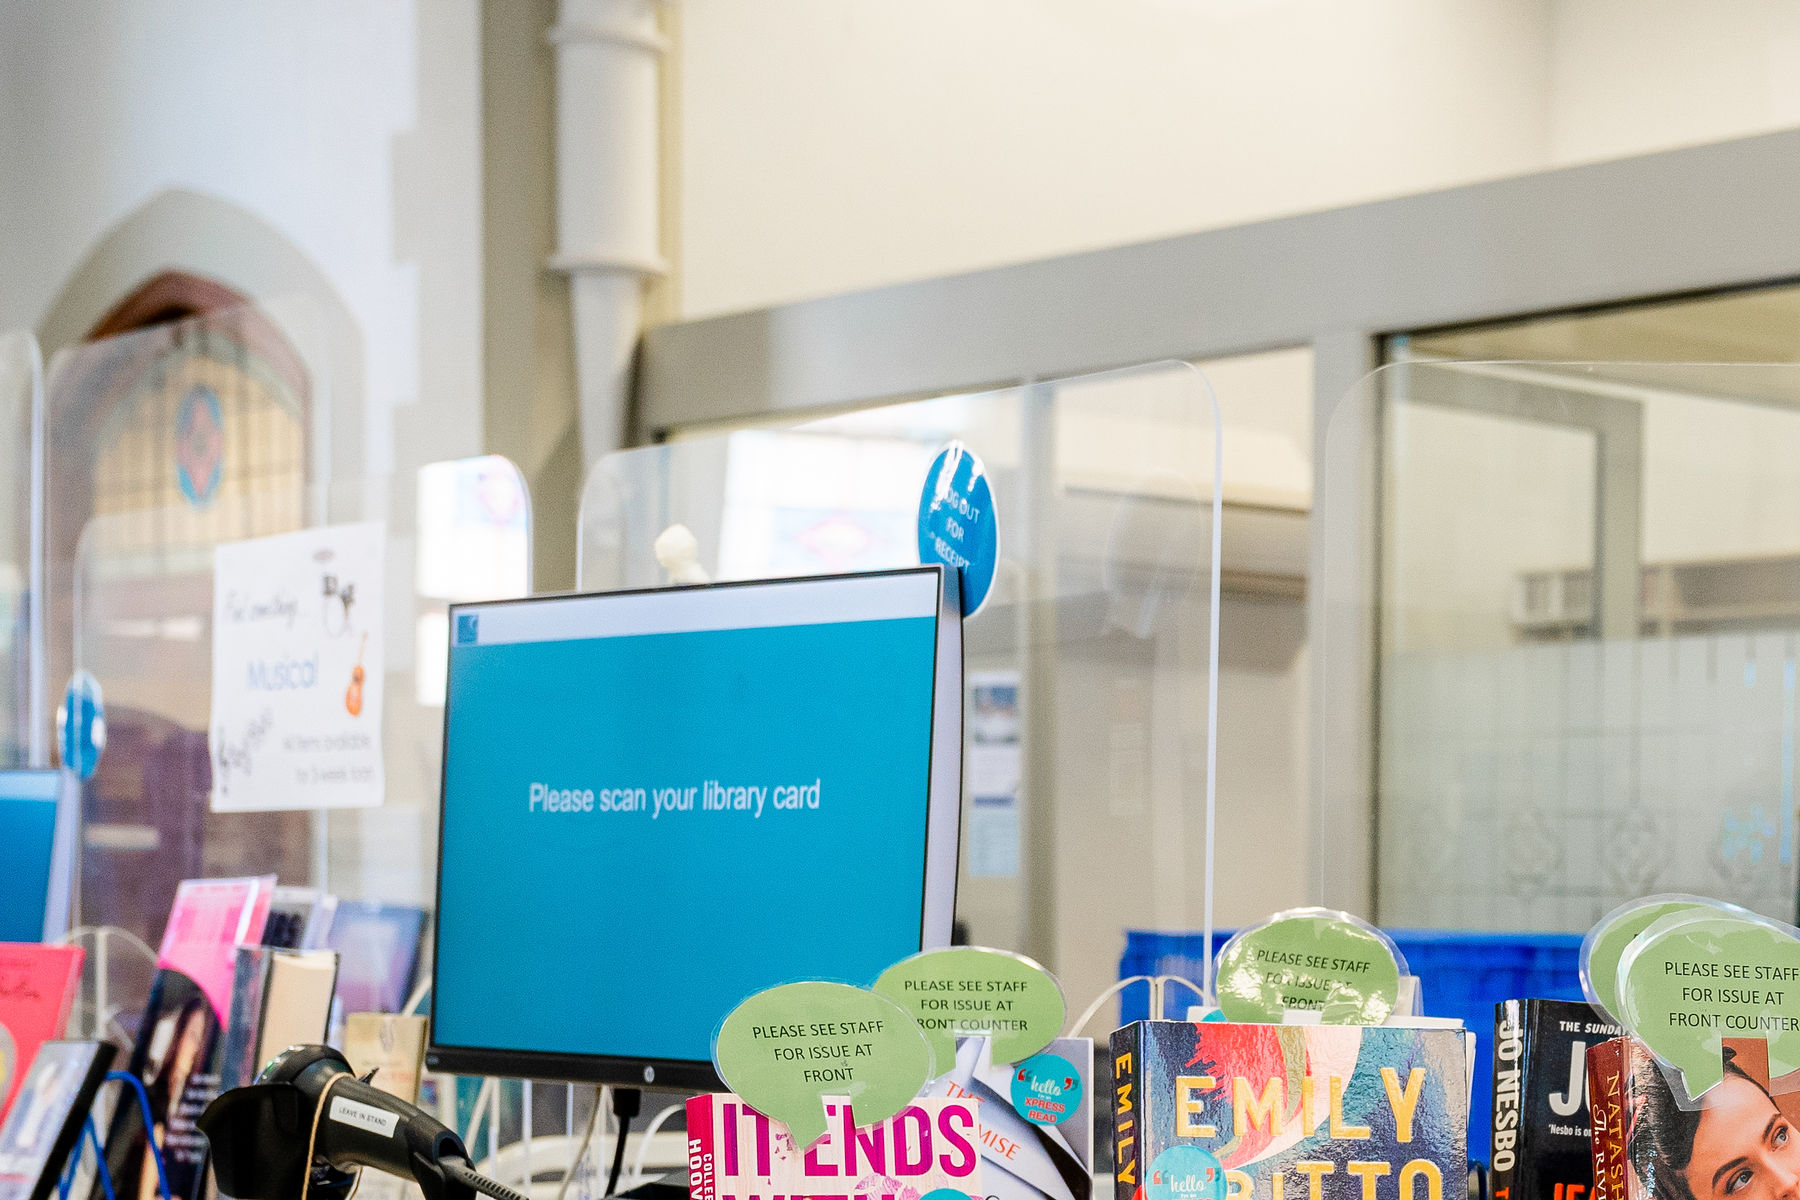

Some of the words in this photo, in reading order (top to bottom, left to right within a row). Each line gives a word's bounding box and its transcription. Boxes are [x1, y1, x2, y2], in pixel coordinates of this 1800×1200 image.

[935, 537, 970, 574] RECEIPT
[529, 782, 594, 812] Please
[600, 788, 646, 811] scan
[652, 787, 697, 819] your
[703, 780, 767, 818] library
[772, 777, 821, 809] card
[1257, 950, 1303, 966] PLEASE
[1331, 958, 1371, 974] STAFF
[1664, 961, 1720, 978] PLEASE
[1724, 963, 1751, 979] SEE
[1755, 965, 1800, 982] STAFF
[904, 980, 954, 993] PLEASE
[958, 980, 982, 993] SEE
[986, 980, 1028, 993] STAFF
[1682, 987, 1715, 1002] FOR
[1718, 988, 1760, 1005] ISSUE
[1765, 990, 1785, 1005] AT
[921, 999, 949, 1012] FOR
[953, 999, 990, 1012] ISSUE
[995, 999, 1014, 1012] AT
[752, 1023, 807, 1039] PLEASE
[811, 1021, 837, 1036] SEE
[840, 1019, 885, 1035] STAFF
[959, 1018, 1028, 1031] COUNTER
[1669, 1012, 1721, 1029] FRONT
[1725, 1013, 1800, 1032] COUNTER
[1498, 1018, 1523, 1062] JO
[774, 1046, 806, 1061] FOR
[809, 1044, 849, 1060] ISSUE
[853, 1042, 873, 1057] AT
[803, 1067, 854, 1083] FRONT
[339, 1107, 357, 1118] LEAVE
[1024, 1097, 1065, 1113] XPRESS
[1175, 1067, 1426, 1143] EMILY
[1028, 1109, 1057, 1123] READ
[1115, 1052, 1136, 1185] EMILY
[1493, 1066, 1522, 1173] NESBO
[722, 1103, 771, 1176] IT
[804, 1103, 977, 1178] ENDS
[1170, 1174, 1204, 1192] hello
